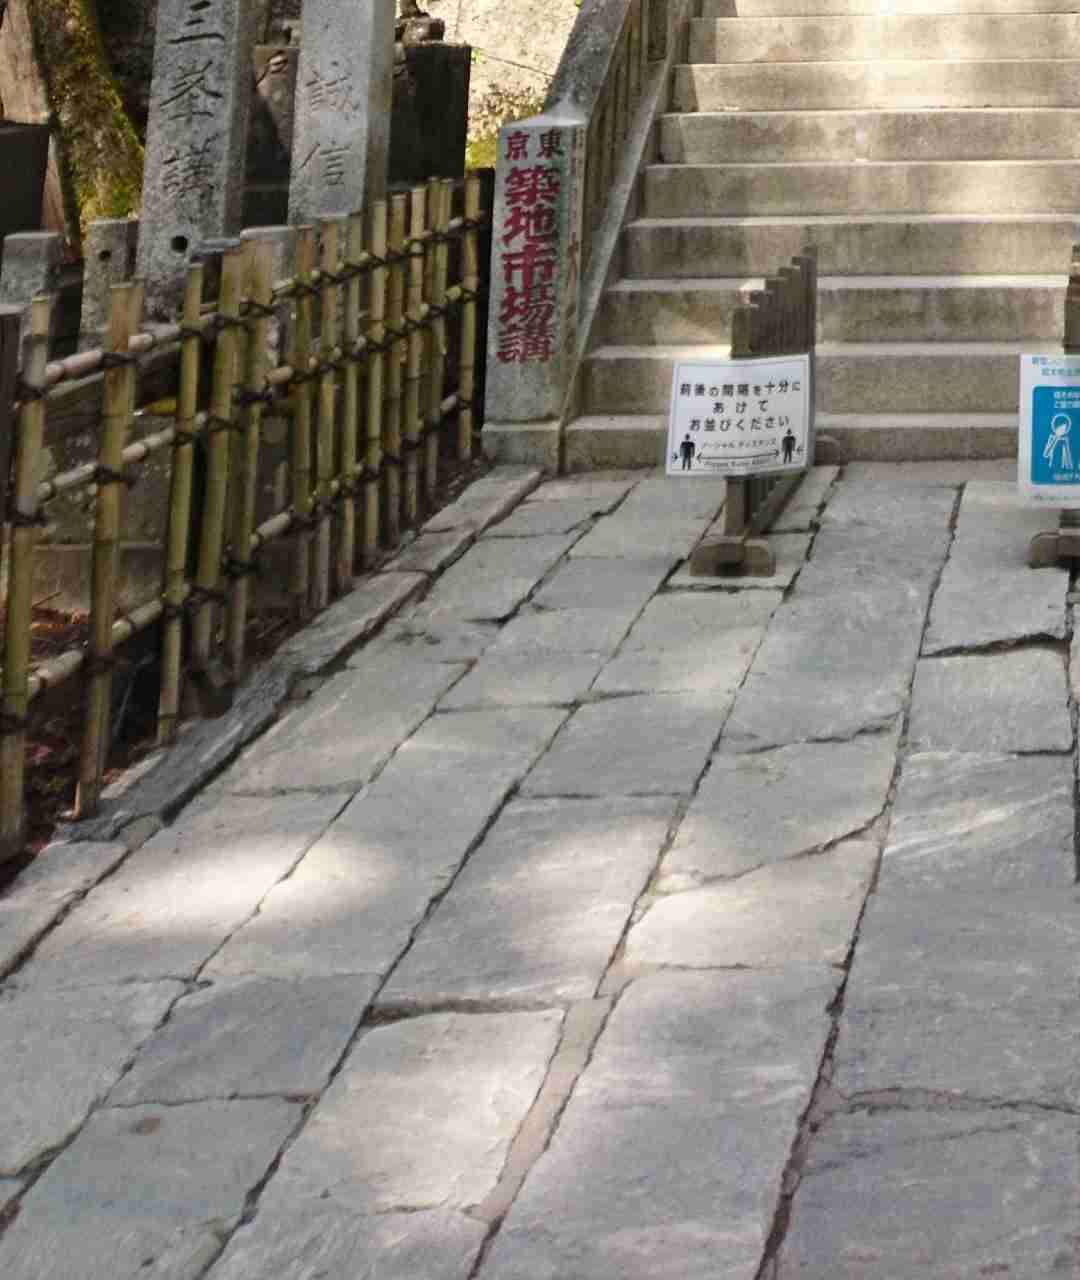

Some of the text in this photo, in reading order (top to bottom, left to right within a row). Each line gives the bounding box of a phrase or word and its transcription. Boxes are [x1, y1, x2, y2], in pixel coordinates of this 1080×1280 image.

[680, 380, 801, 397] 前後の間隔を十分に
[713, 400, 768, 414] あけて
[690, 416, 790, 432] お並びください
